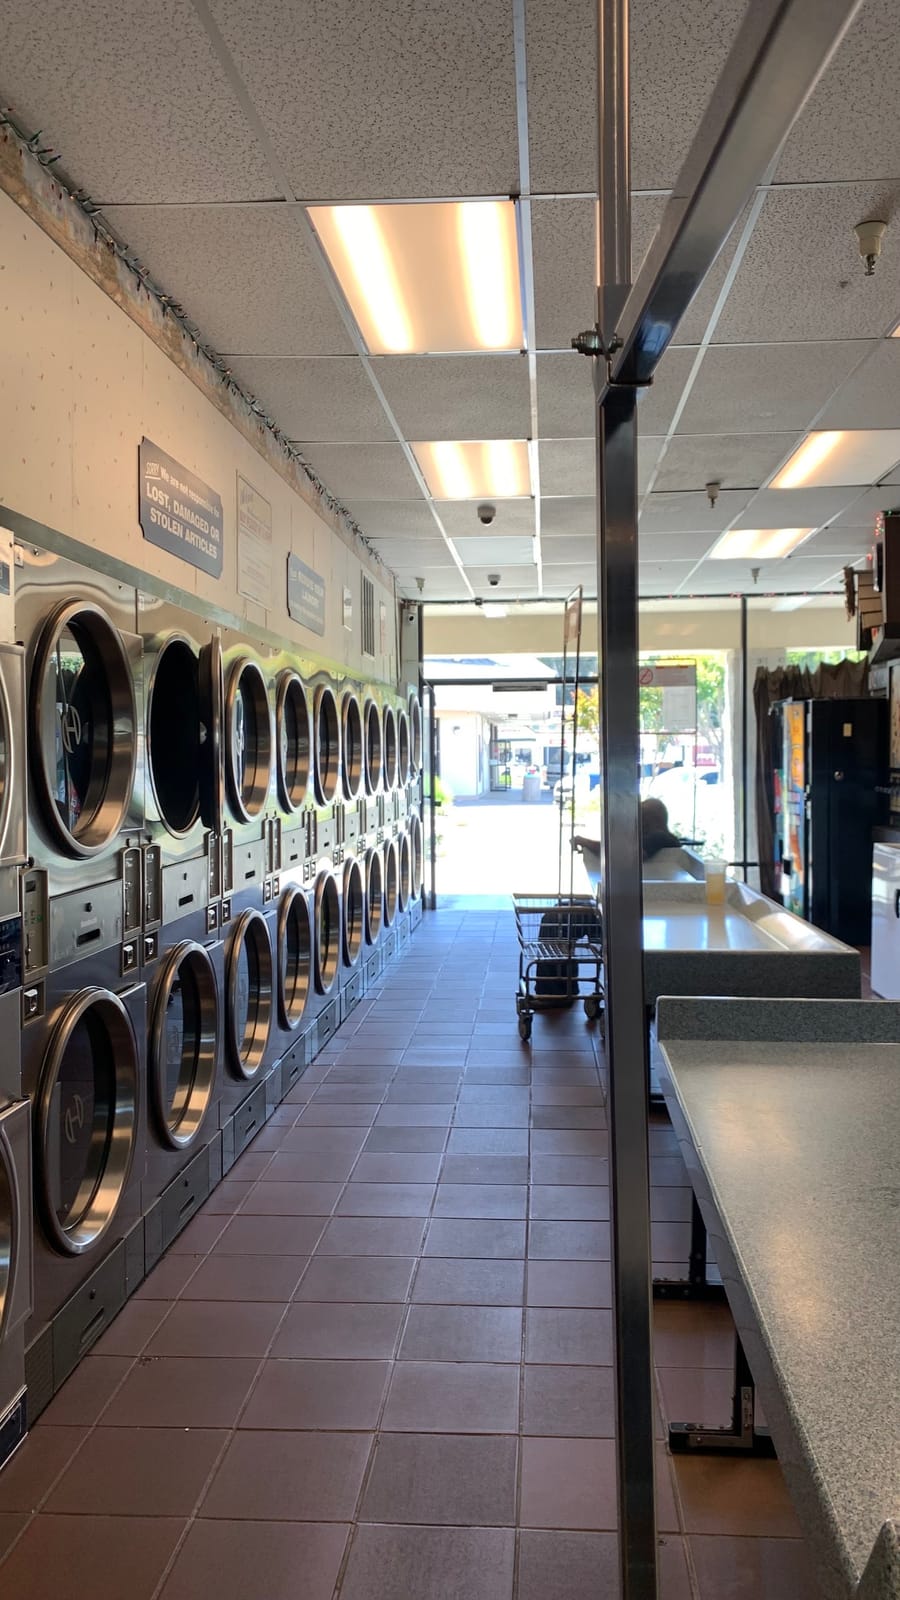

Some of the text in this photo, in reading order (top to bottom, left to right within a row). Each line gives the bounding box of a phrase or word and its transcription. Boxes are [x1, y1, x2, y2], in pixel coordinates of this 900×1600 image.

[160, 466, 170, 482] We
[170, 475, 179, 489] are
[146, 482, 171, 512] LOST,
[173, 499, 209, 534] DAMAGED
[210, 526, 220, 543] OR
[150, 507, 184, 538] STOLEN
[185, 528, 218, 559] ARTICLES
